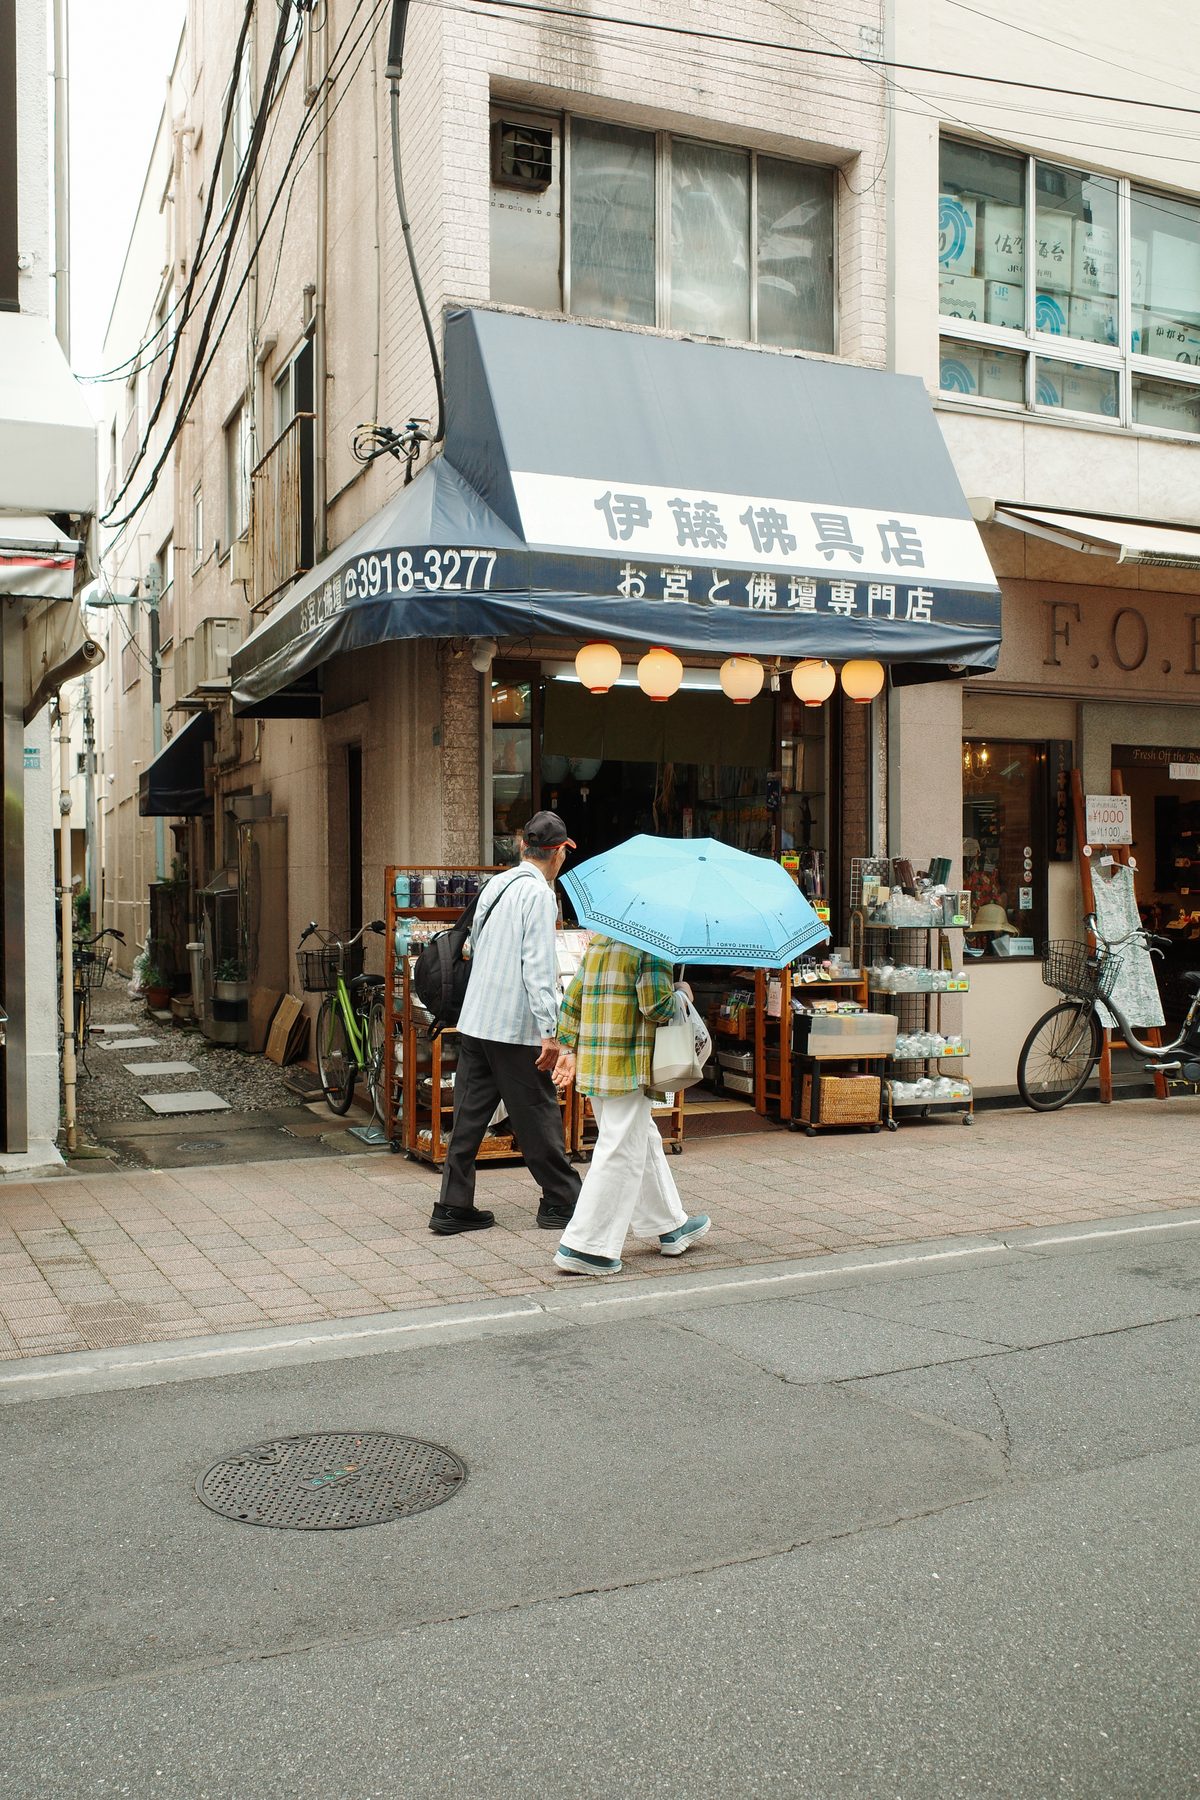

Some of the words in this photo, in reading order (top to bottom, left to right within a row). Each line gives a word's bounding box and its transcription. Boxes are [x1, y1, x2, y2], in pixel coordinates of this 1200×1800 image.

[1155, 325, 1186, 343] かがわ
[594, 490, 925, 569] 伊藤佛具店
[358, 549, 498, 599] 3918-3277
[616, 561, 934, 623] お宮と佛壇専門店
[1133, 749, 1156, 761] Fresh
[1158, 750, 1171, 765] Off
[1173, 751, 1186, 762] the
[628, 920, 647, 931] TOKYO
